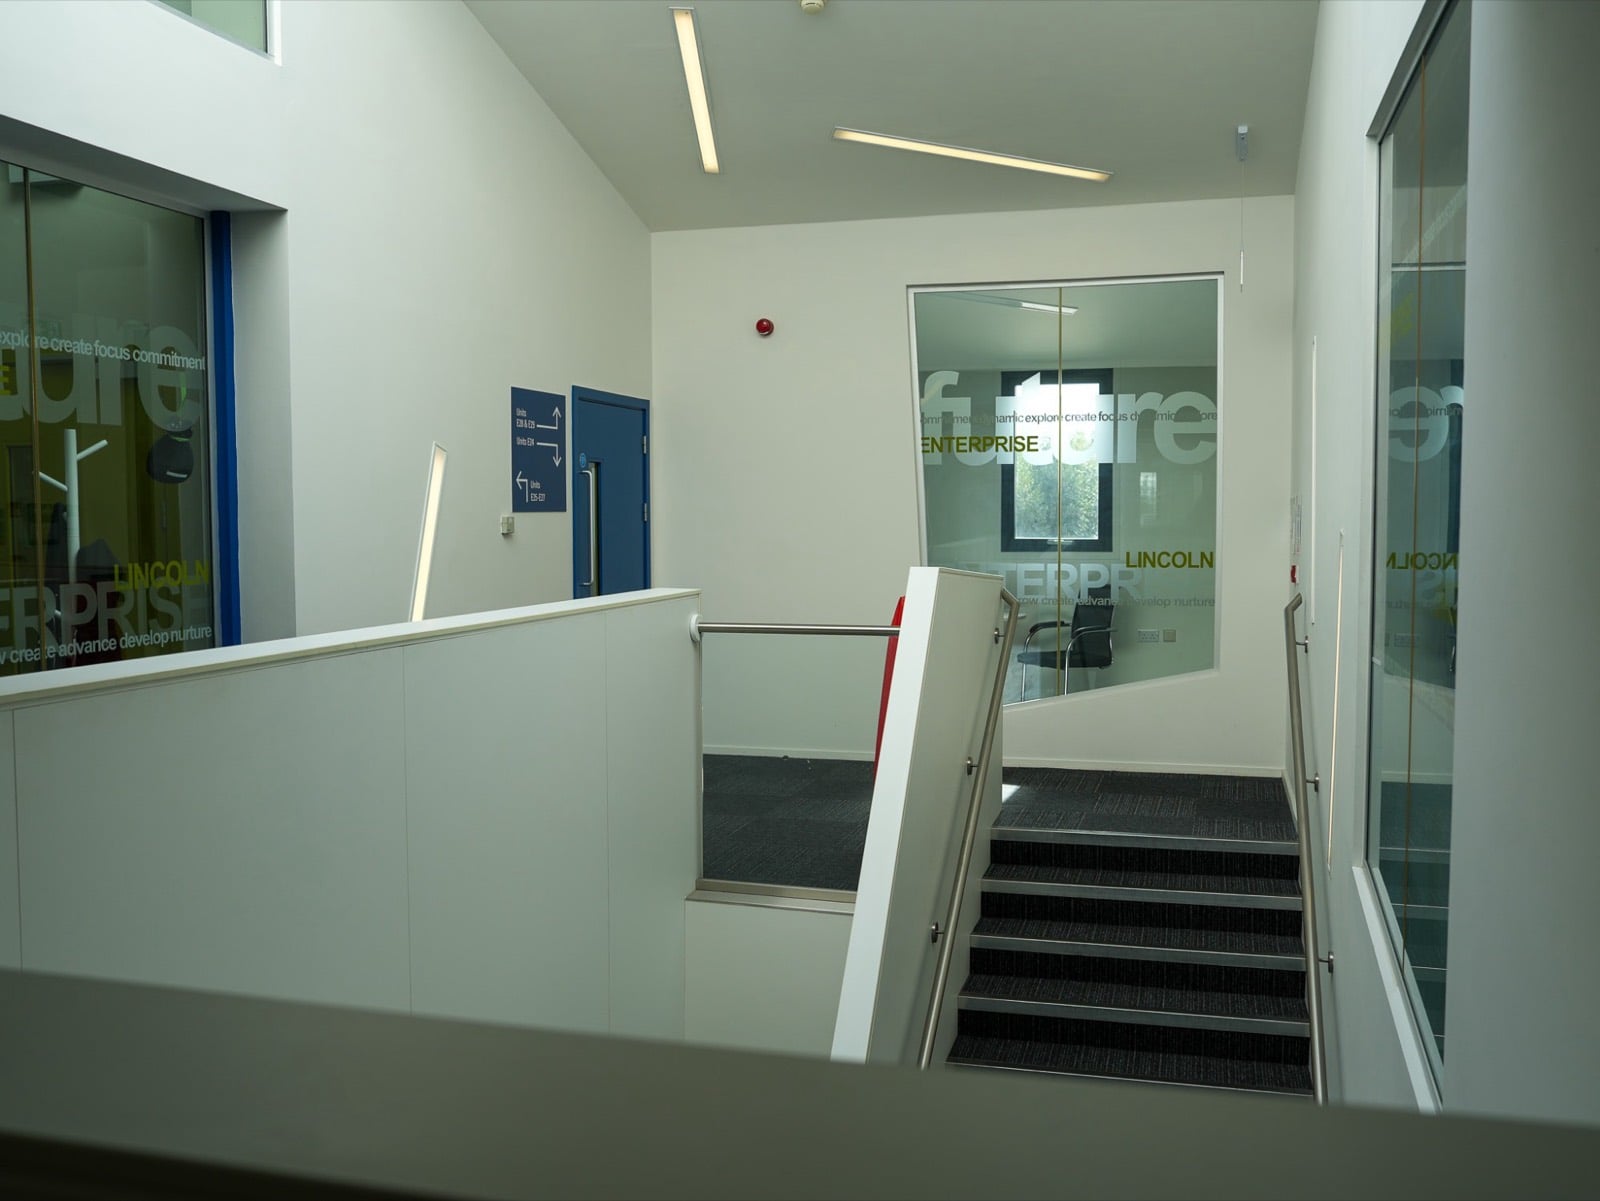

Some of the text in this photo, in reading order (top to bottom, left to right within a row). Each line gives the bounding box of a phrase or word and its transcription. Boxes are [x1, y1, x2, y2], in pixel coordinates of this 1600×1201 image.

[50, 337, 93, 356] create
[94, 340, 130, 361] focus
[133, 348, 205, 370] commitment
[1065, 411, 1097, 422] create
[921, 436, 1039, 453] ENTERPRISE
[1125, 551, 1214, 569] LINCOLN
[114, 560, 209, 591] LINCOLN
[58, 636, 117, 657] advance
[119, 632, 169, 648] develop
[170, 625, 212, 642] nurture
